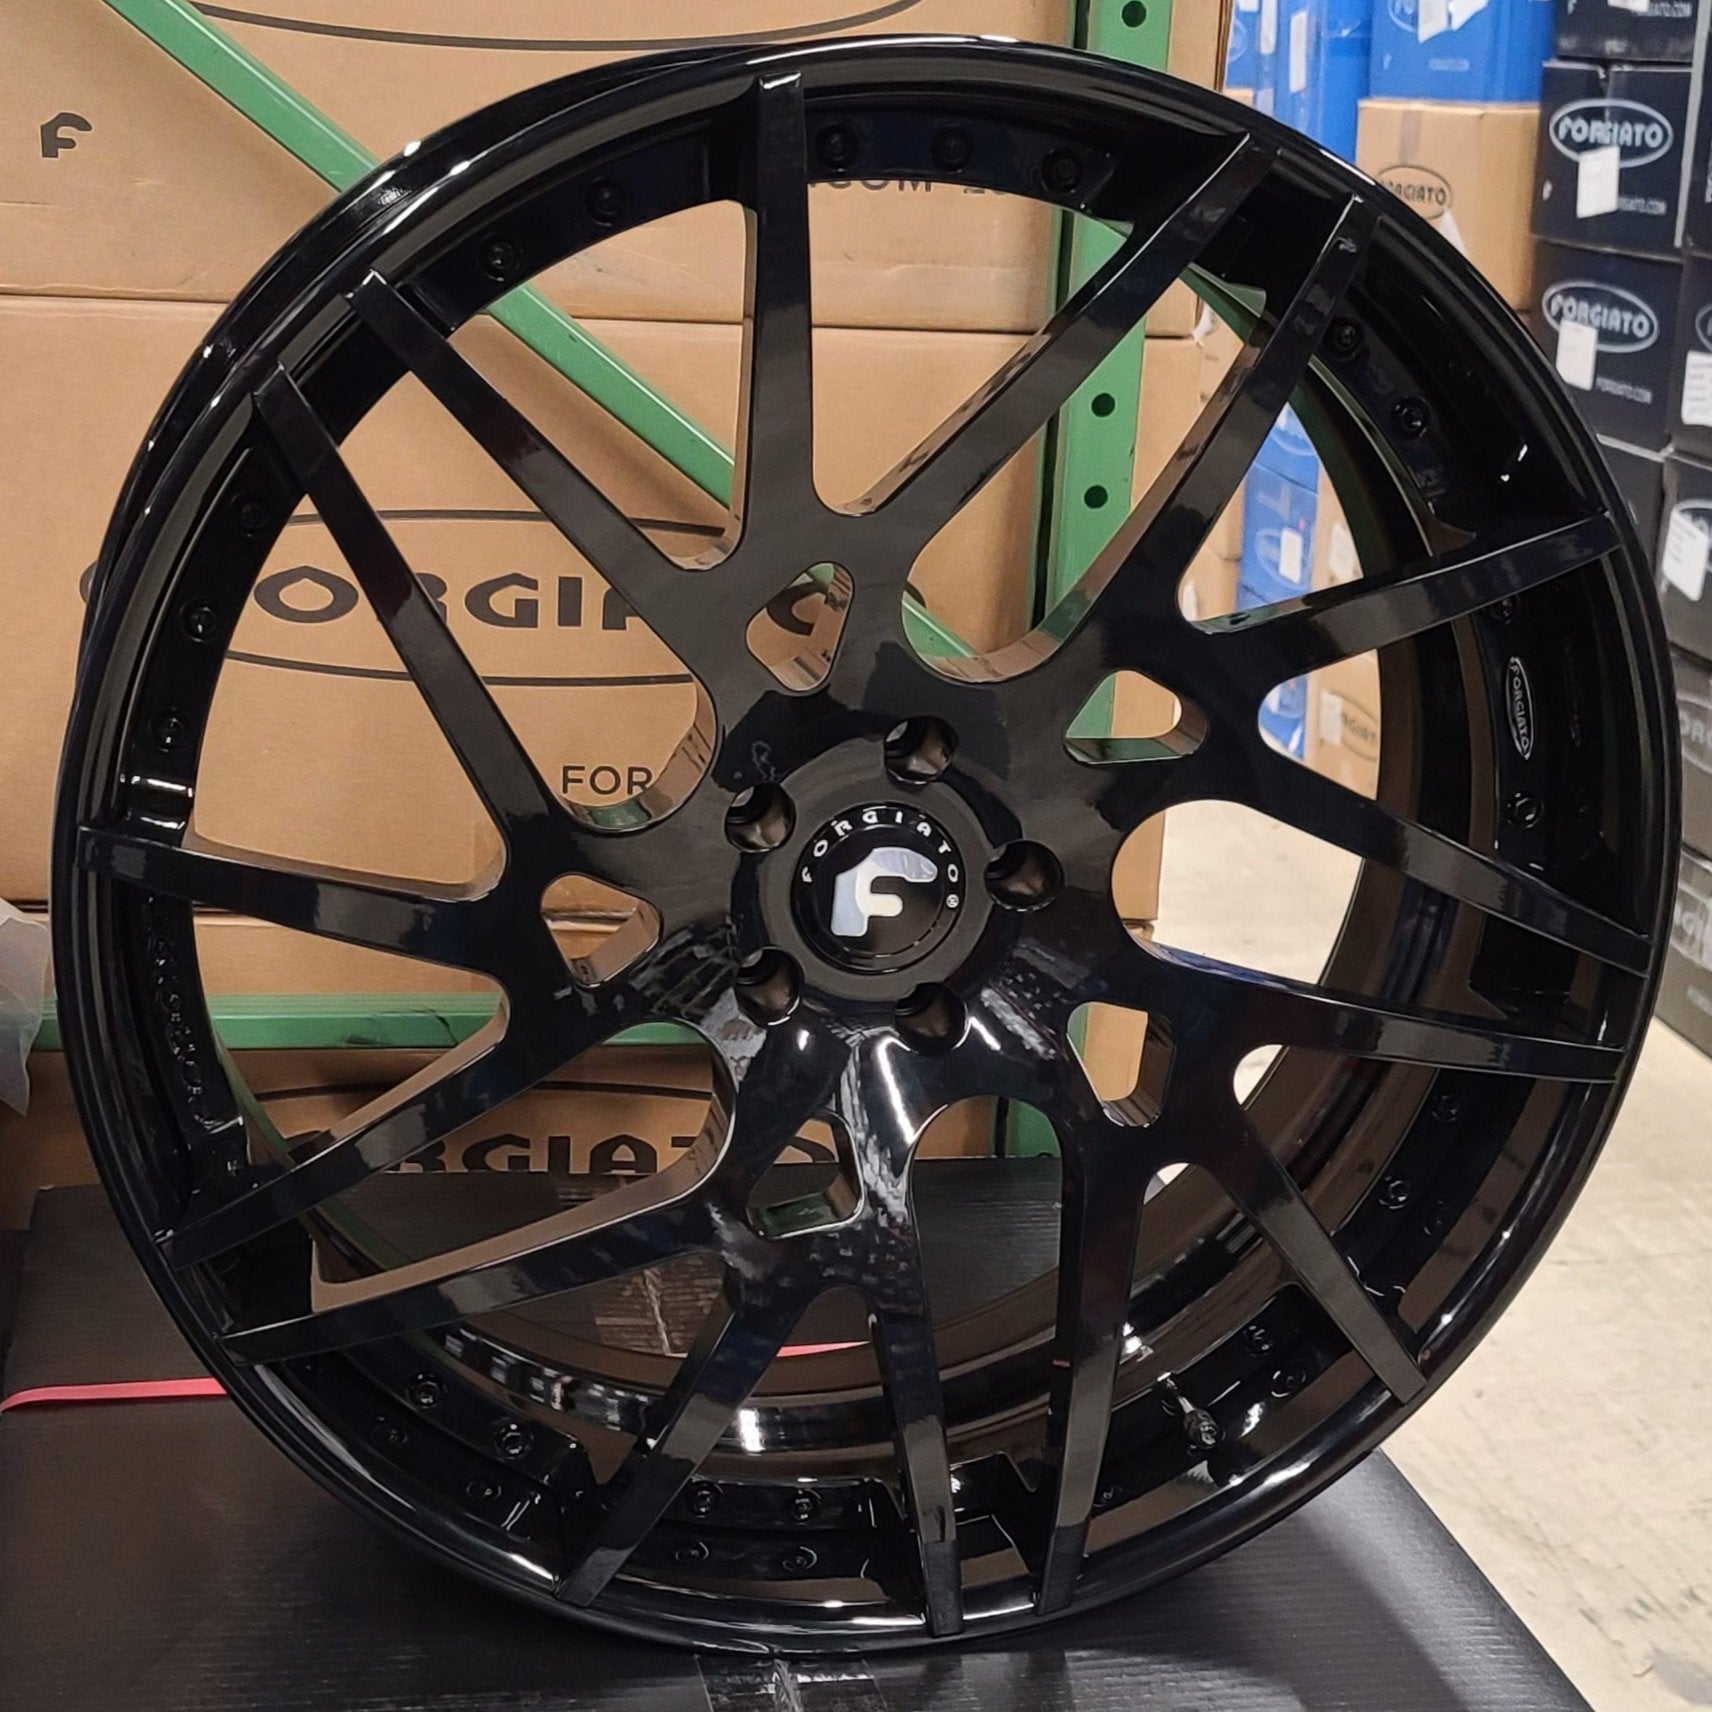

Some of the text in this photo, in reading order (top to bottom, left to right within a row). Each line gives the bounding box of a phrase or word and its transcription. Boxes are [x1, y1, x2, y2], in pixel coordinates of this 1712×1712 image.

[41, 112, 92, 158] F
[1558, 114, 1664, 149] FORGIATO
[1510, 664, 1530, 753] FORGIATO
